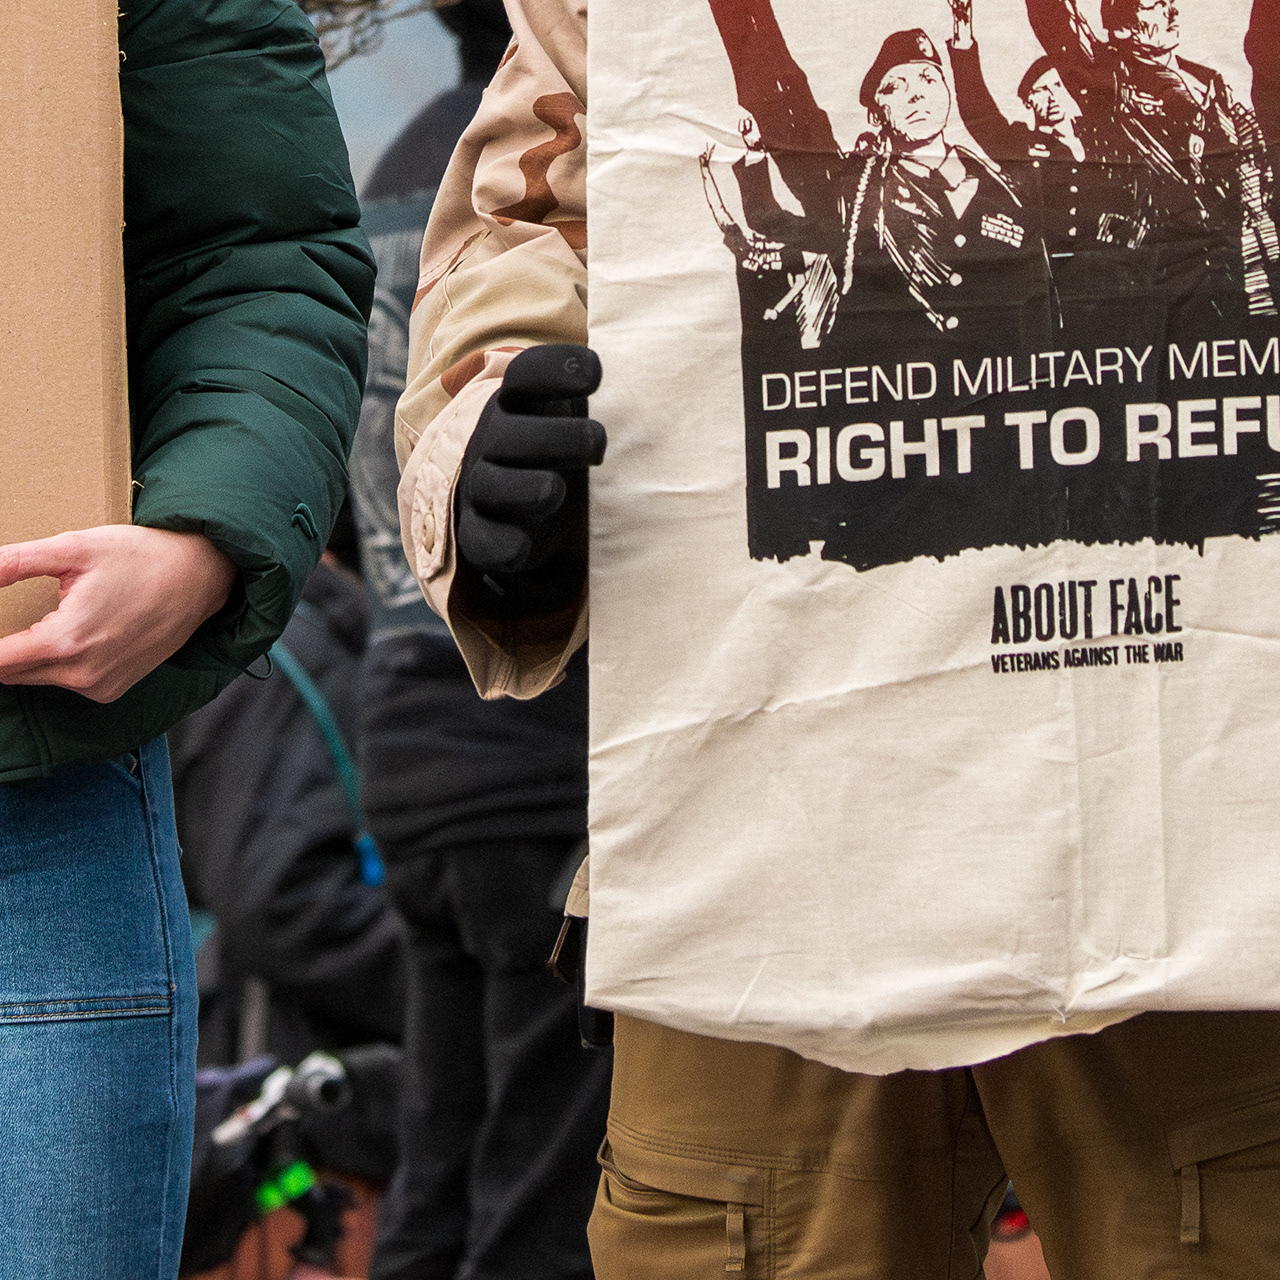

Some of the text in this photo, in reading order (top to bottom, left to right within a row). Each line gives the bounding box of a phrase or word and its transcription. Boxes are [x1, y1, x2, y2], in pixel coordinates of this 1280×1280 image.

[761, 361, 937, 411] DEFEND
[953, 345, 1153, 396] MILITARY
[765, 415, 986, 489] RIGHT
[1005, 406, 1101, 470] TO
[990, 574, 1183, 644] ABOUT FACE
[991, 642, 1184, 674] VETERANS AGAINST THE WAR
